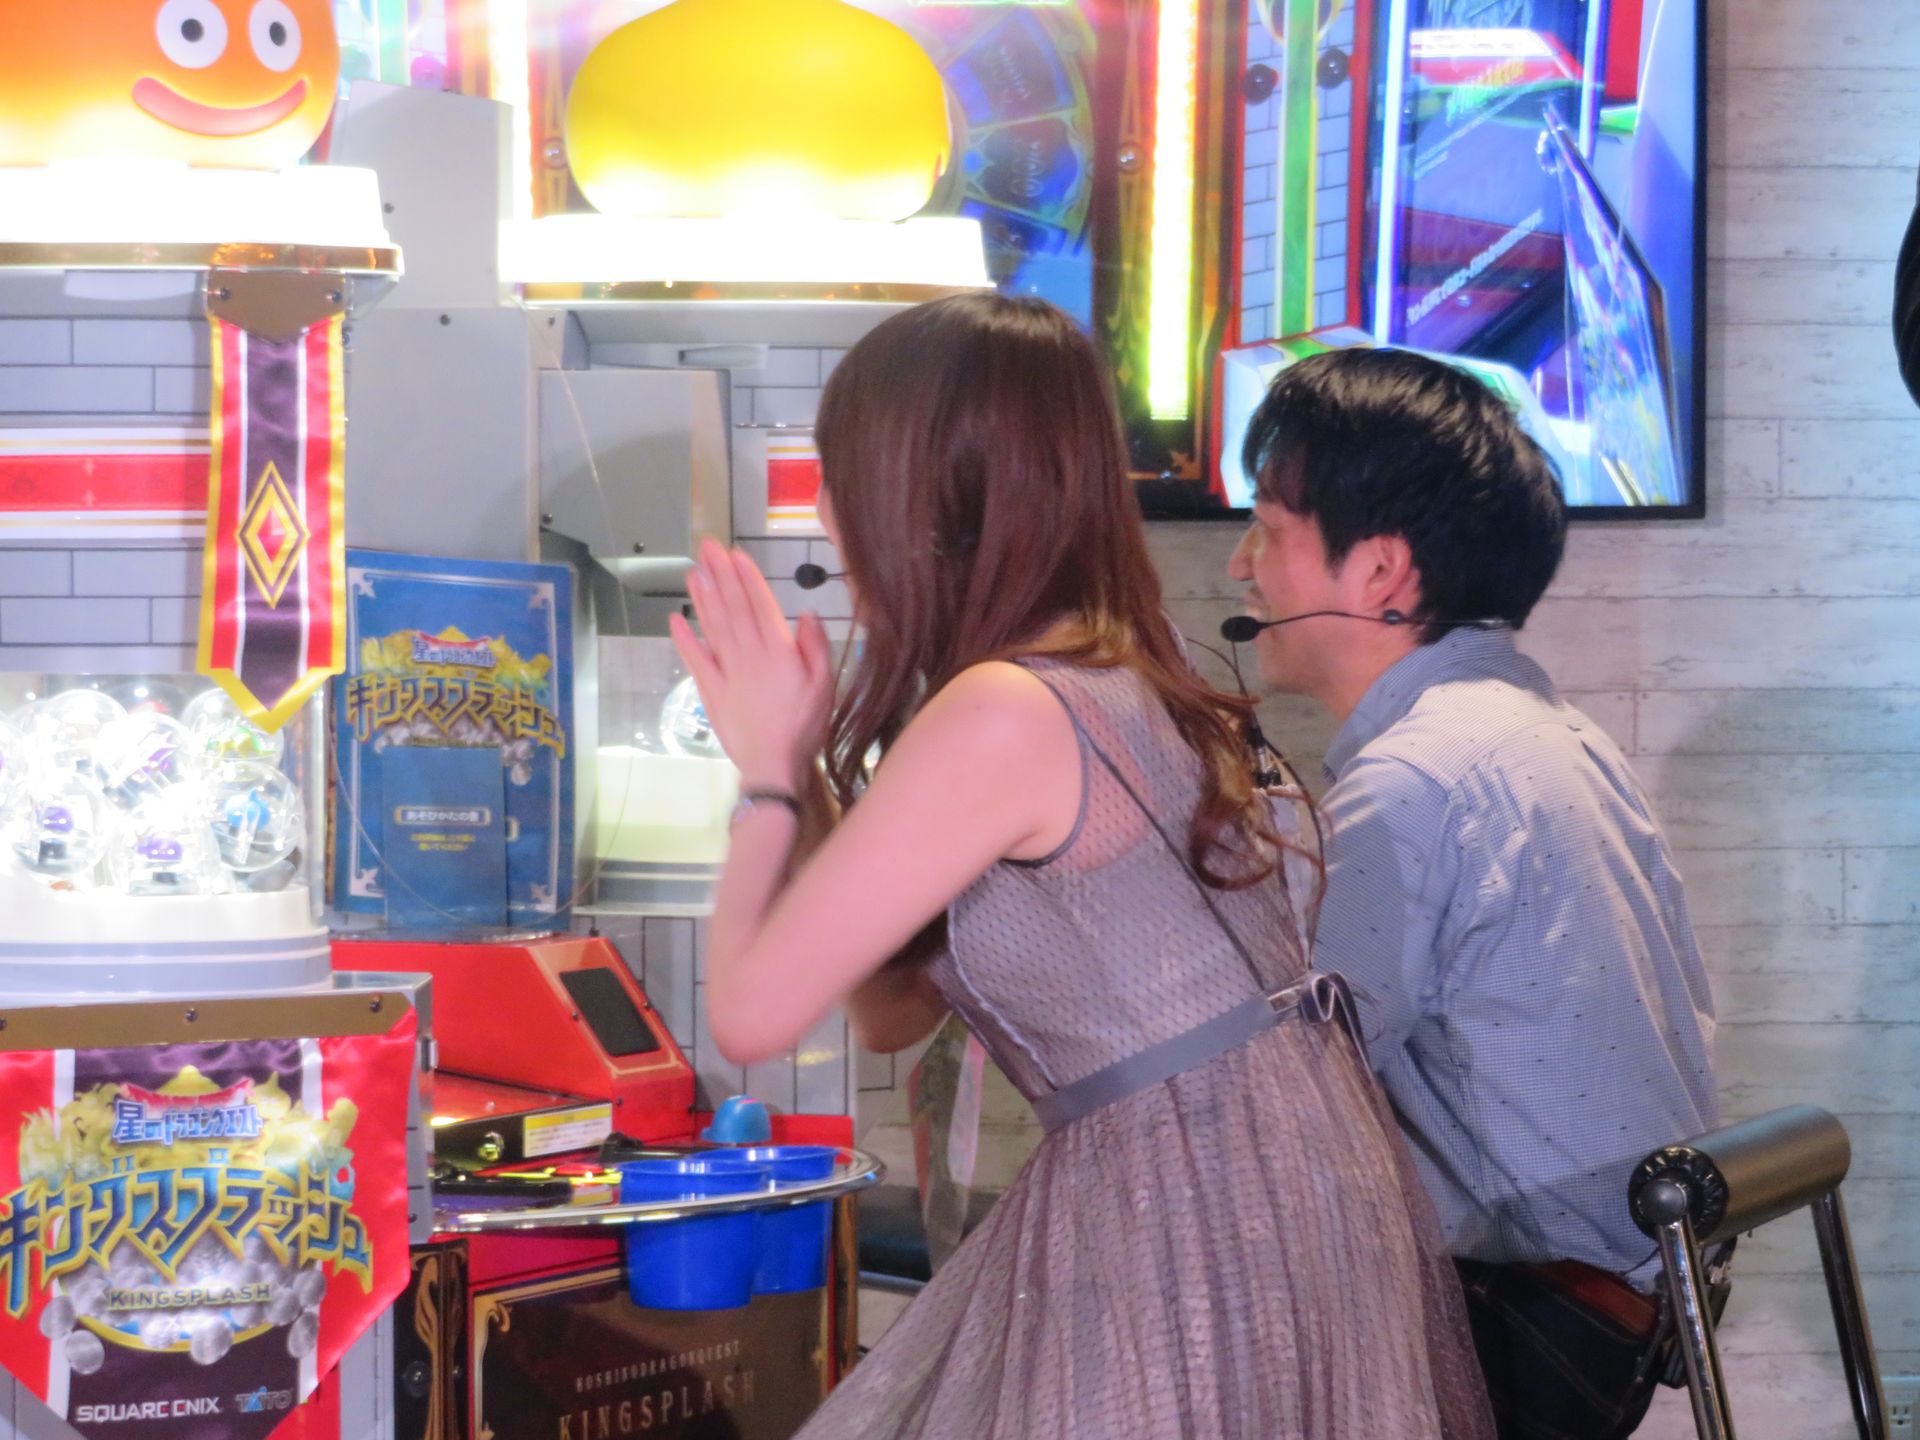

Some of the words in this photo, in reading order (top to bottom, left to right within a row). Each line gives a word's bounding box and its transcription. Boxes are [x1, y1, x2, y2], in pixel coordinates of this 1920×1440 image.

[347, 668, 565, 758] キングスプラッシュ
[112, 1099, 263, 1145] 星のドラゴンクエスト
[0, 1148, 373, 1318] キングスプラッシュ
[110, 1284, 271, 1308] KINGSPLASH
[76, 1401, 169, 1423] SQUARE
[172, 1396, 222, 1417] ENIX
[235, 1385, 293, 1413] TAITO
